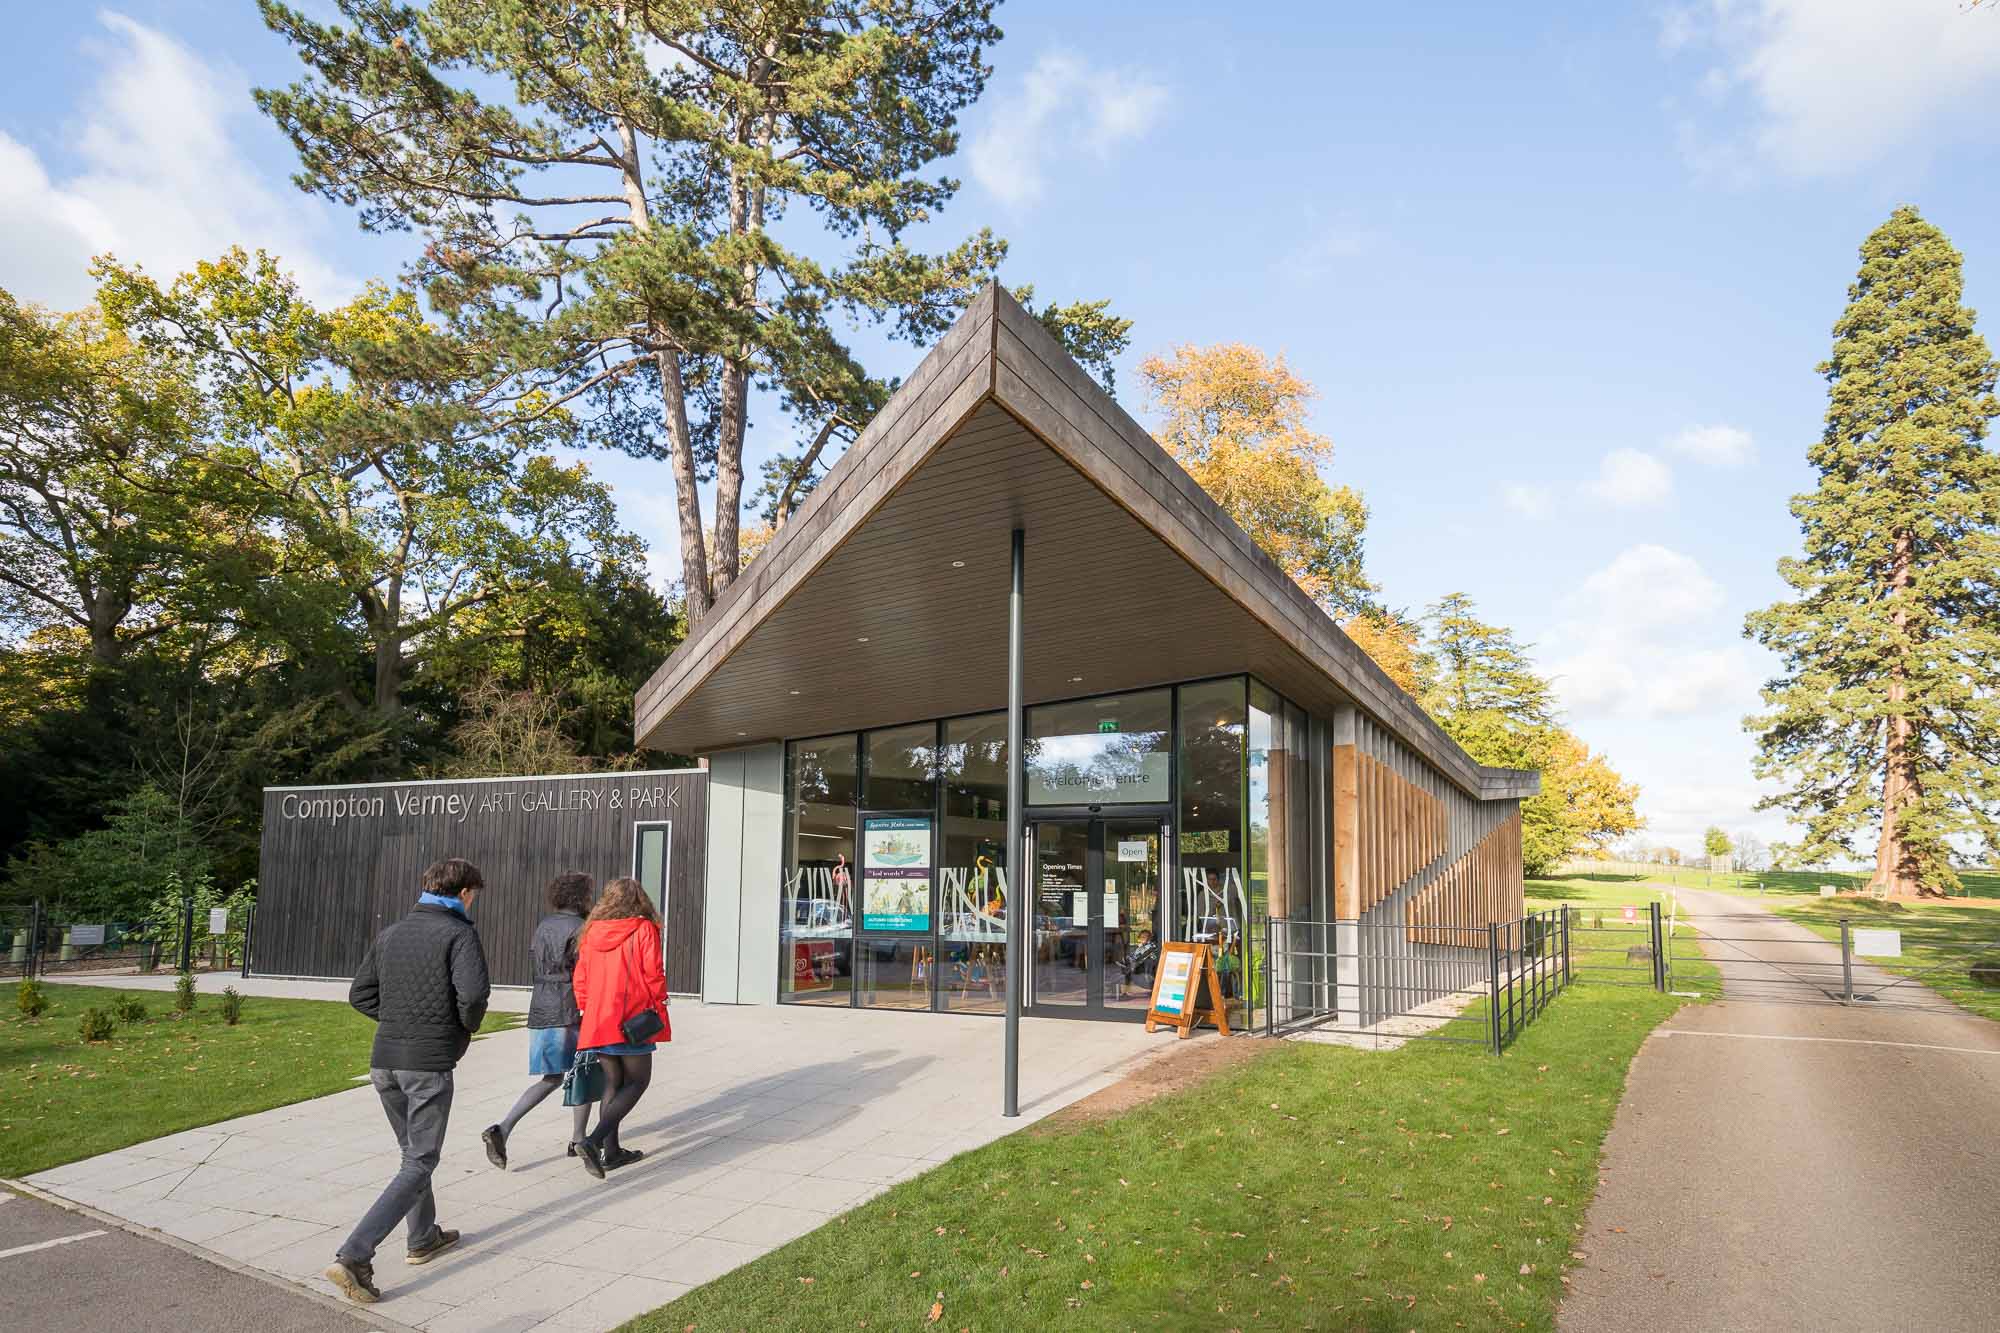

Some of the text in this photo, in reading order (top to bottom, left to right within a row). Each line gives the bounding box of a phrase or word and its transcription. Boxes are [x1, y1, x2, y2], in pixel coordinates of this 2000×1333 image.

[1104, 772, 1150, 786] entre
[281, 785, 681, 827] Compton Verney ART GALLERY & PARK
[1121, 847, 1144, 857] Open
[1042, 863, 1066, 871] Opening
